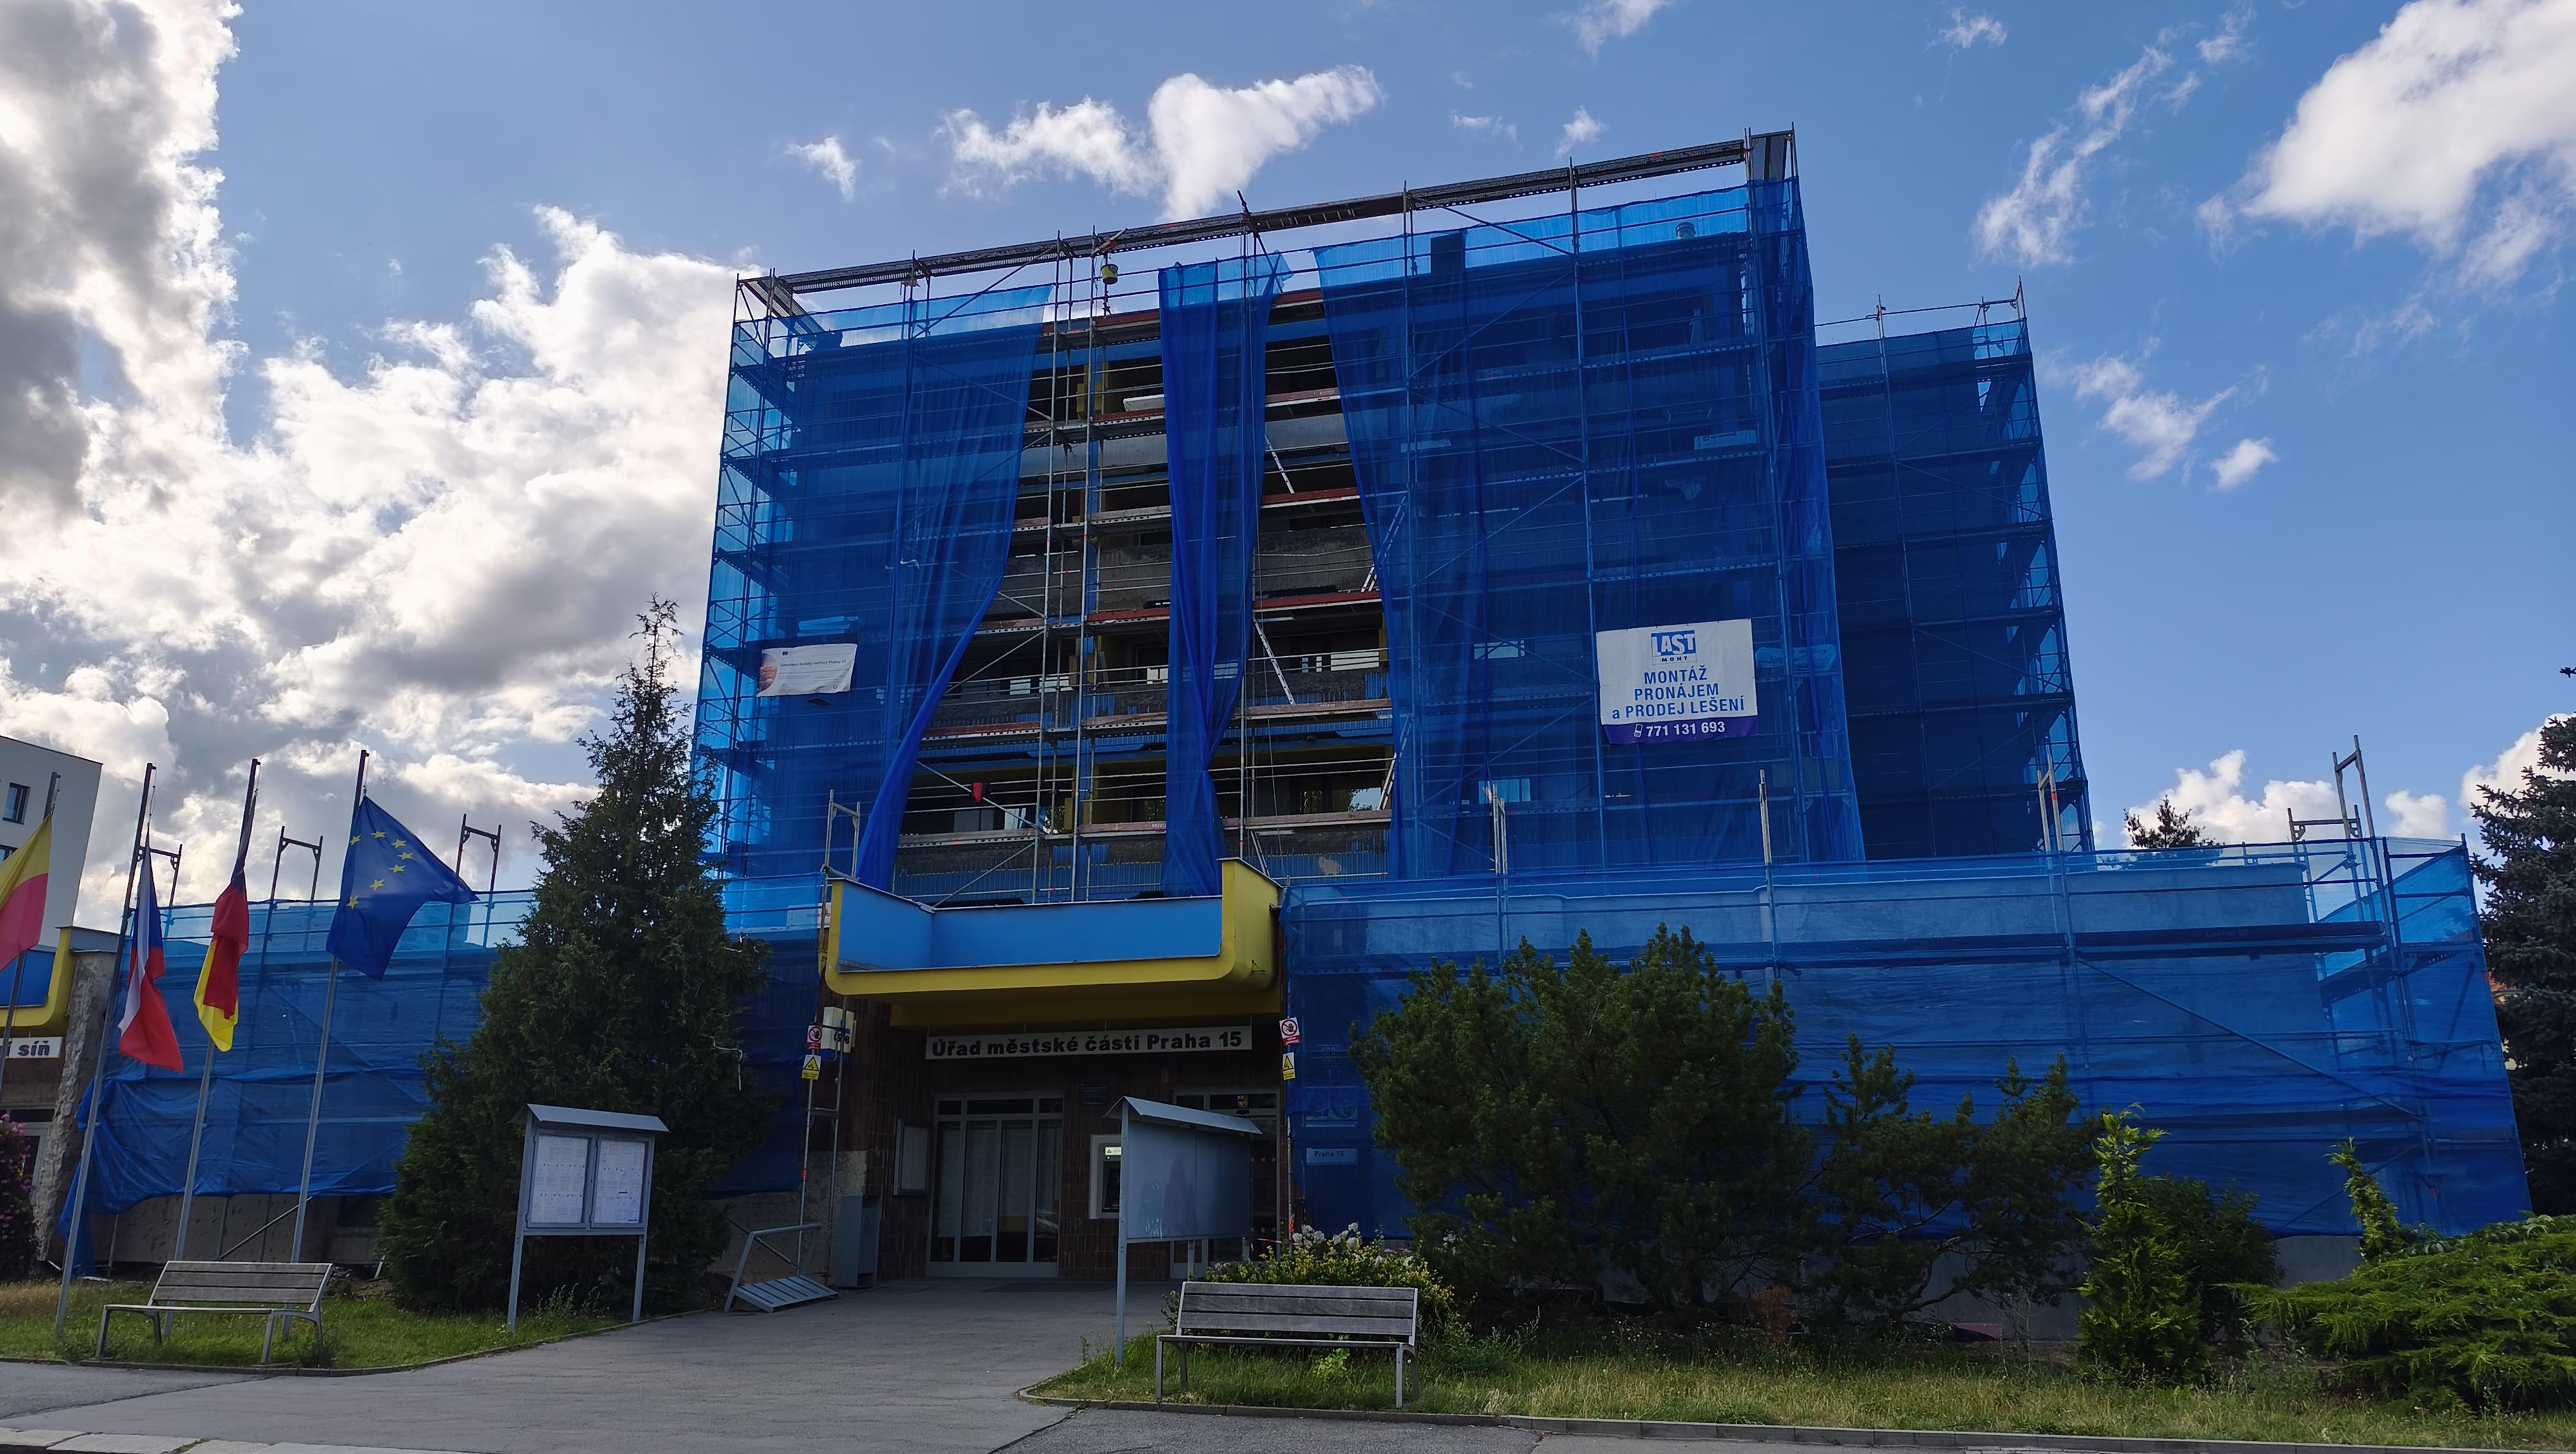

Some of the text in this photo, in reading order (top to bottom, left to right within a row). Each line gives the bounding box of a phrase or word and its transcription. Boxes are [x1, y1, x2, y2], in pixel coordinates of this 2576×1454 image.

[1651, 634, 1695, 656] LAST
[1644, 665, 1707, 684] MONTÁŽ
[1634, 683, 1719, 701] PRONÁJEM
[1612, 695, 1744, 719] a PRODEJ LEŠENÍ
[1646, 721, 1725, 737] 771 131 693
[18, 1041, 50, 1057] síň
[933, 1031, 1242, 1057] Úřad městské části Praha 15
